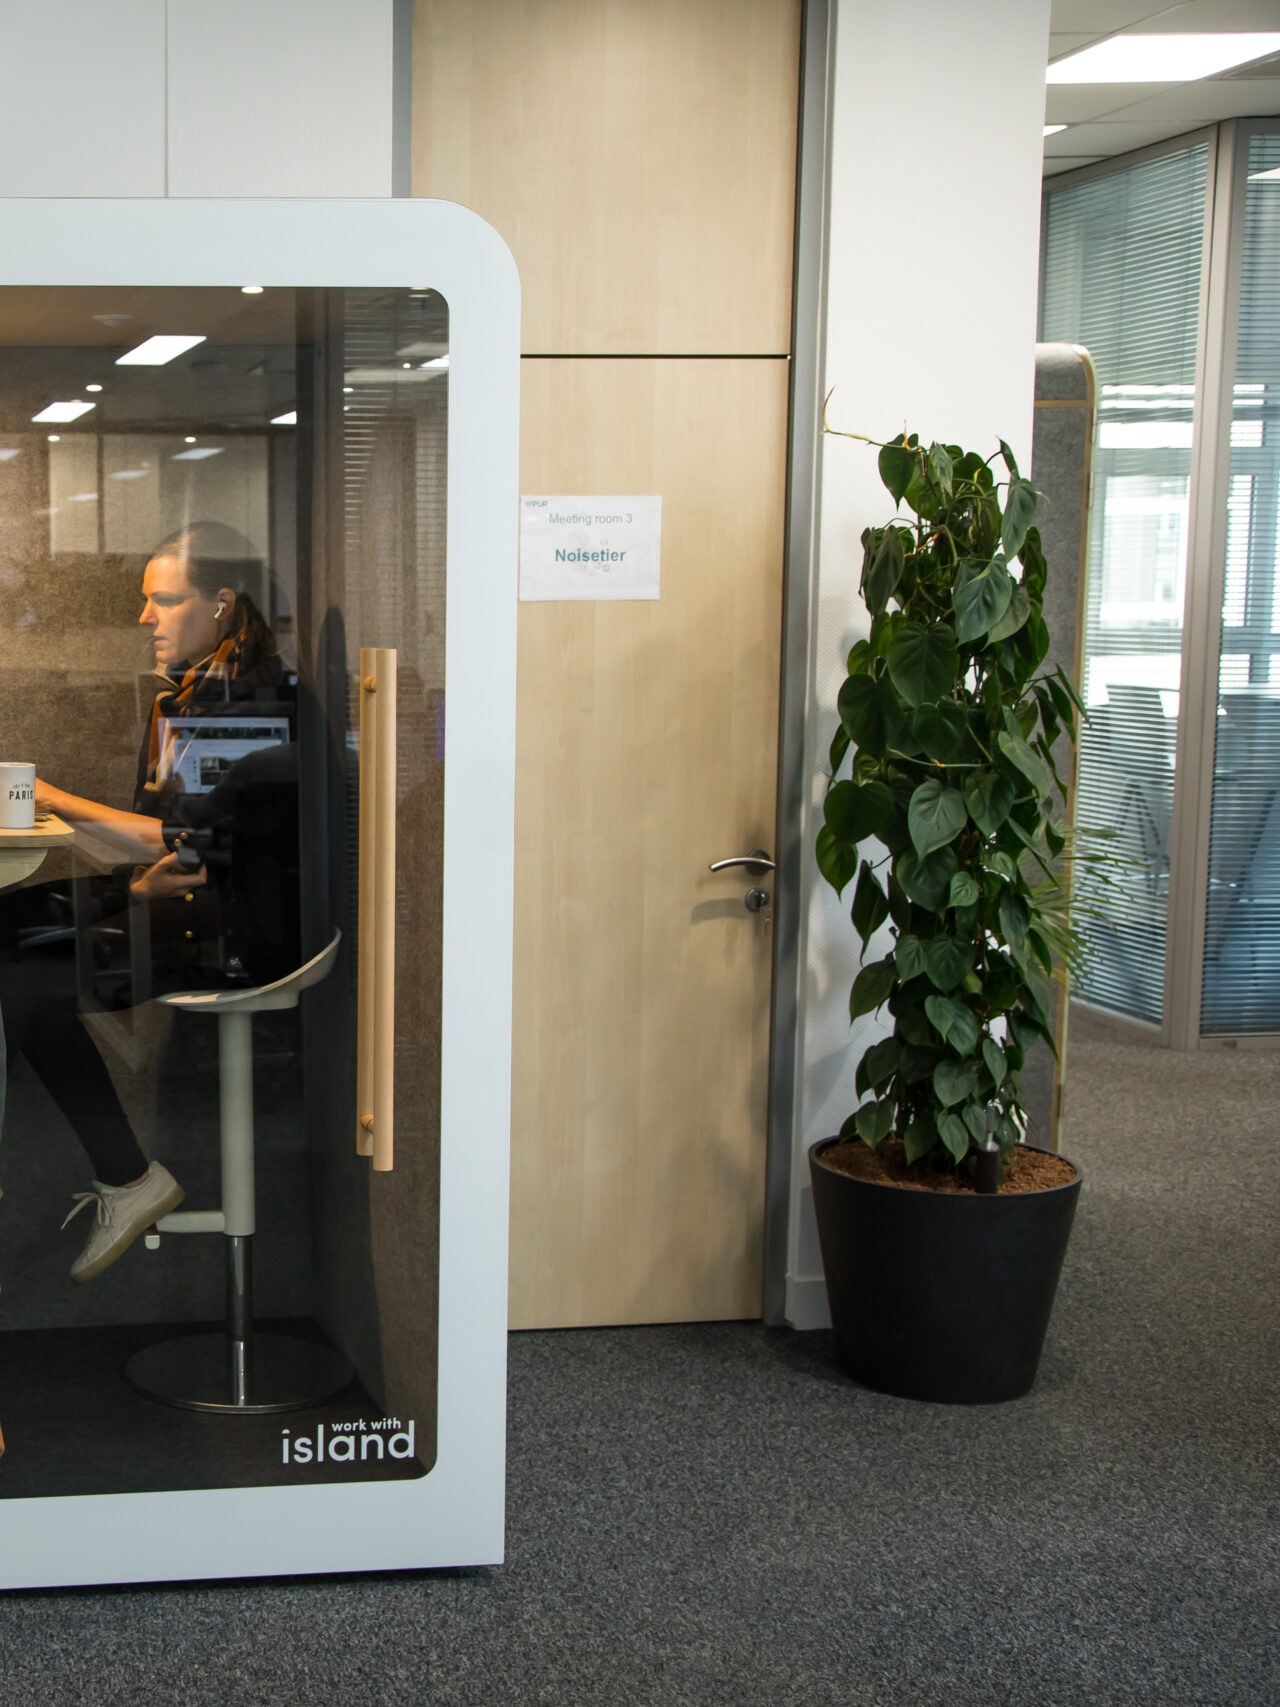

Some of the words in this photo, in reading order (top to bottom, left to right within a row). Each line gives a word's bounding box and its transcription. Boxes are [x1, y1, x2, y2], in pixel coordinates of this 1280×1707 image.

[549, 513, 592, 526] Meeting
[595, 515, 622, 524] room
[625, 513, 633, 524] 3
[555, 549, 626, 562] Noisetier
[8, 790, 34, 800] PARIS
[332, 1418, 366, 1432] work
[371, 1417, 401, 1430] with
[281, 1419, 415, 1464] island
